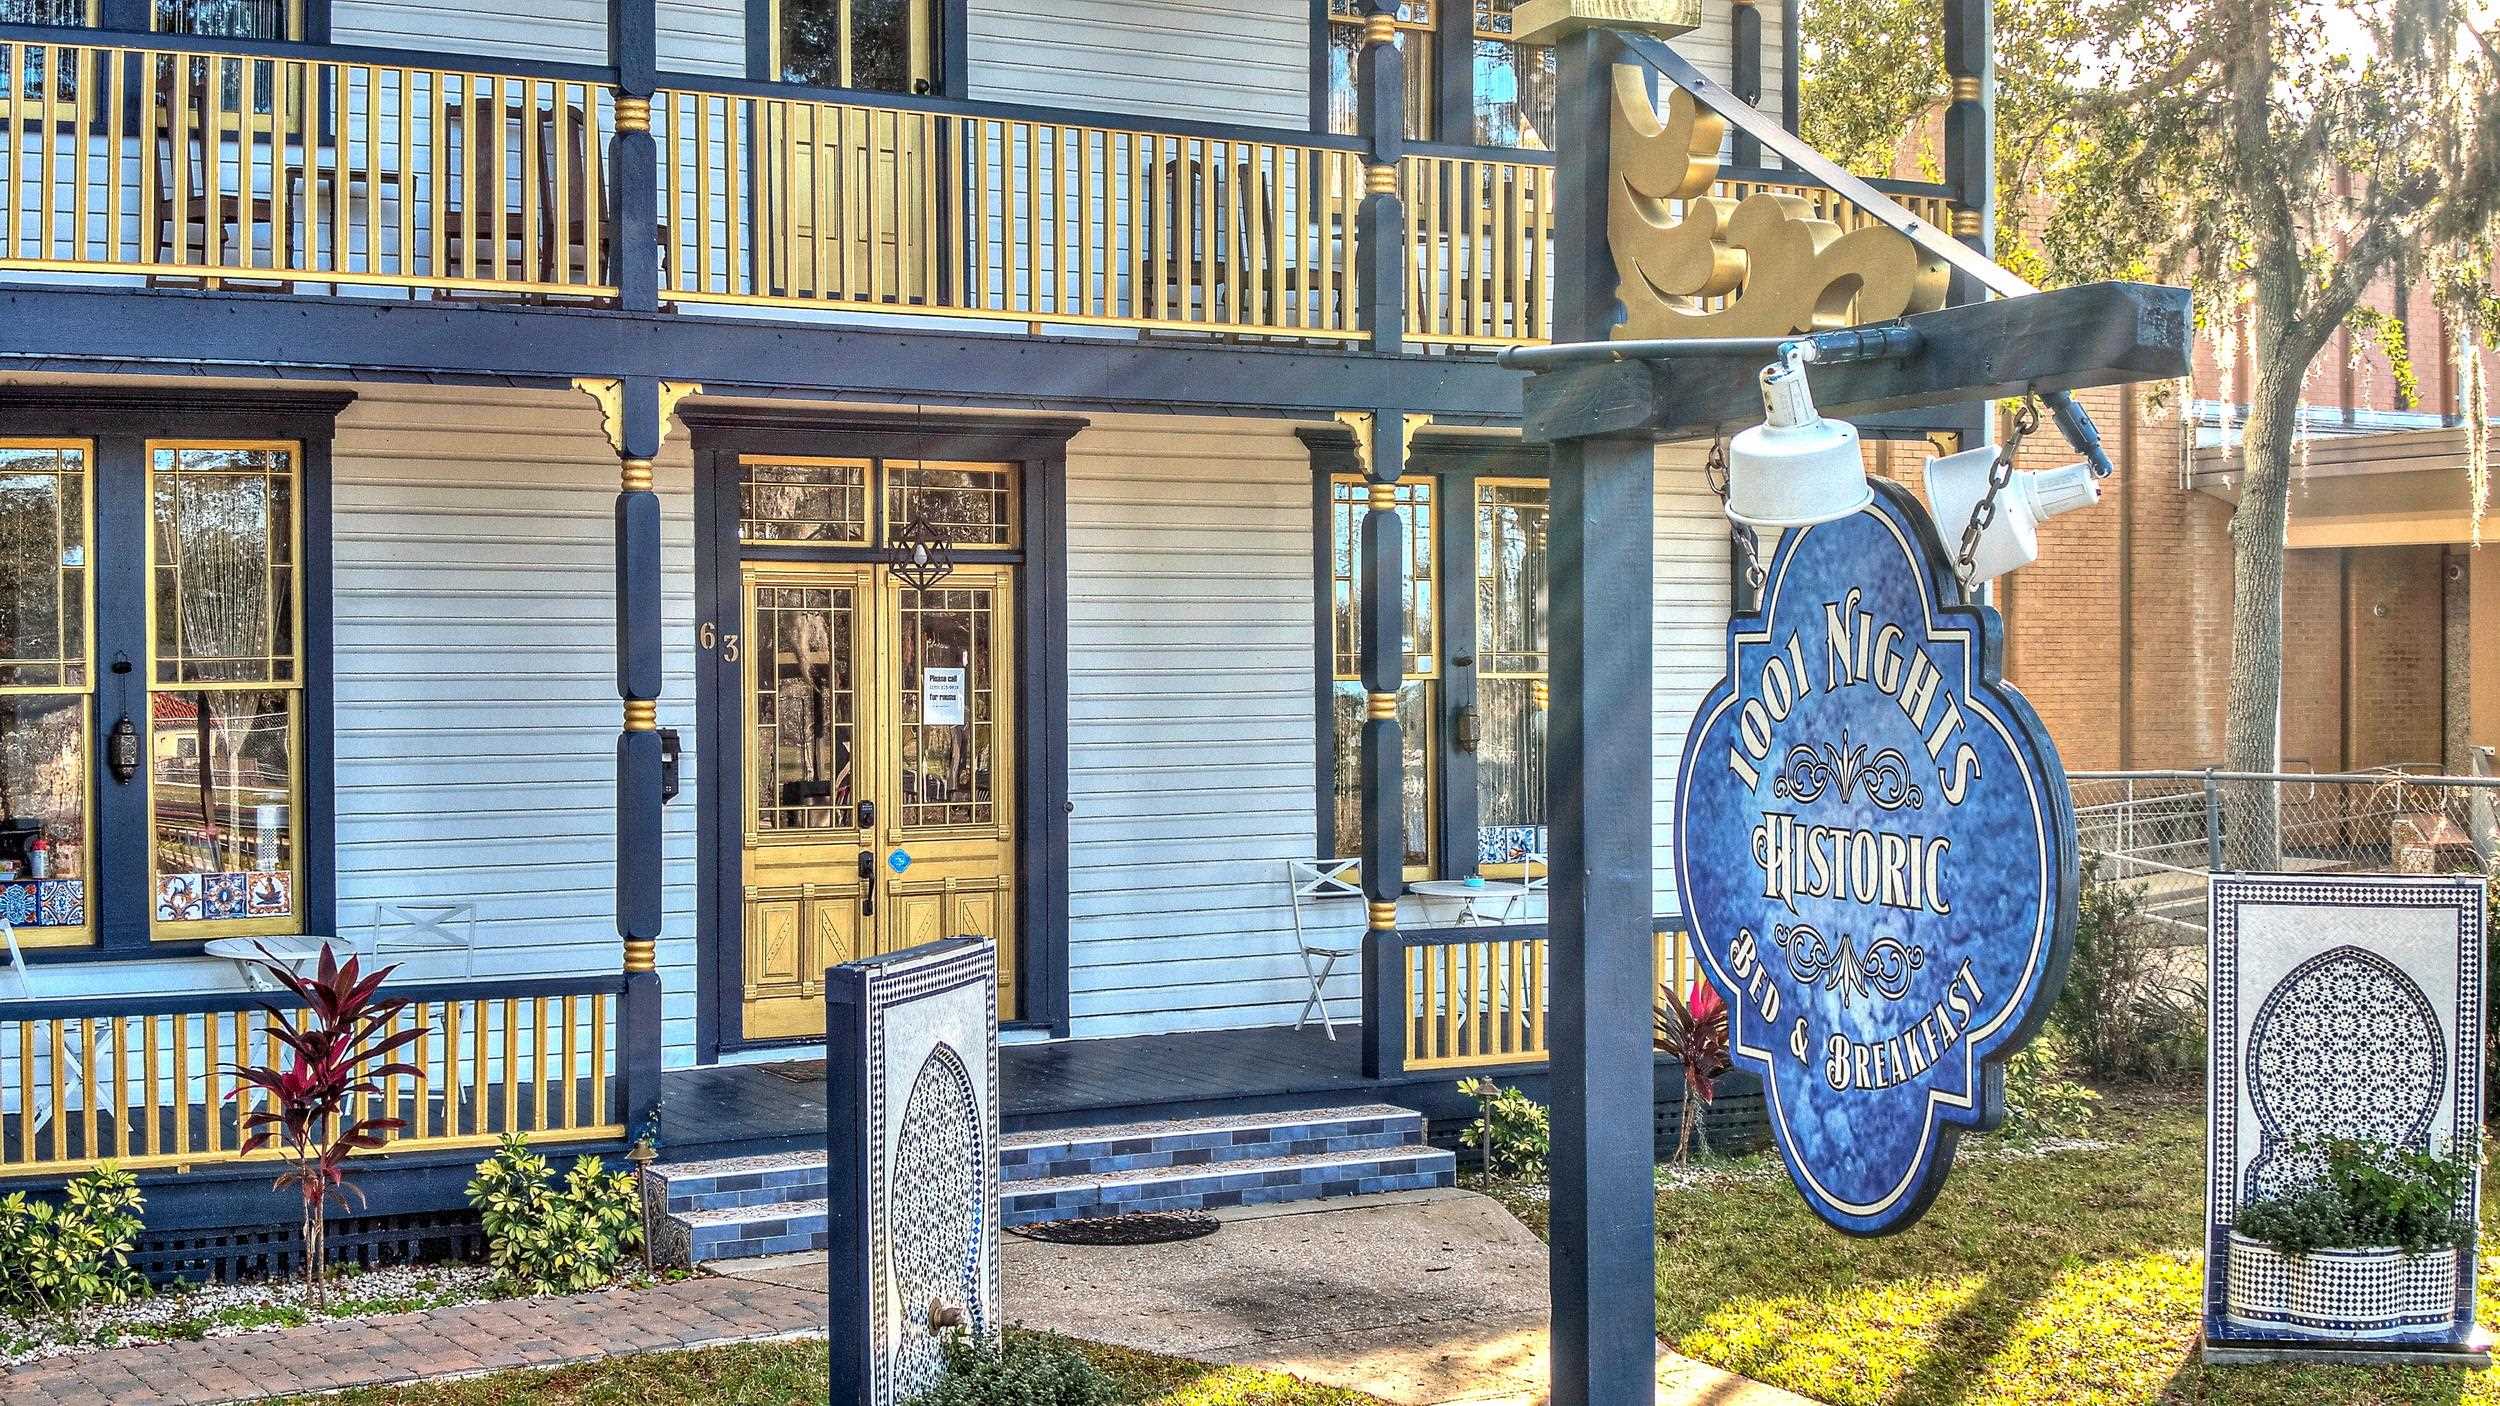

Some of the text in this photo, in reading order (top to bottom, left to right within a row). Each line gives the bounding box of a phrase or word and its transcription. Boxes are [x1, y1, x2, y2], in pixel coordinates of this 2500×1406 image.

[700, 622, 739, 662] 63
[1730, 587, 1982, 806] 1001 NIGHTS
[1752, 811, 1951, 916] HISTORIC
[1730, 927, 1985, 1092] BED & BREAKFAST
